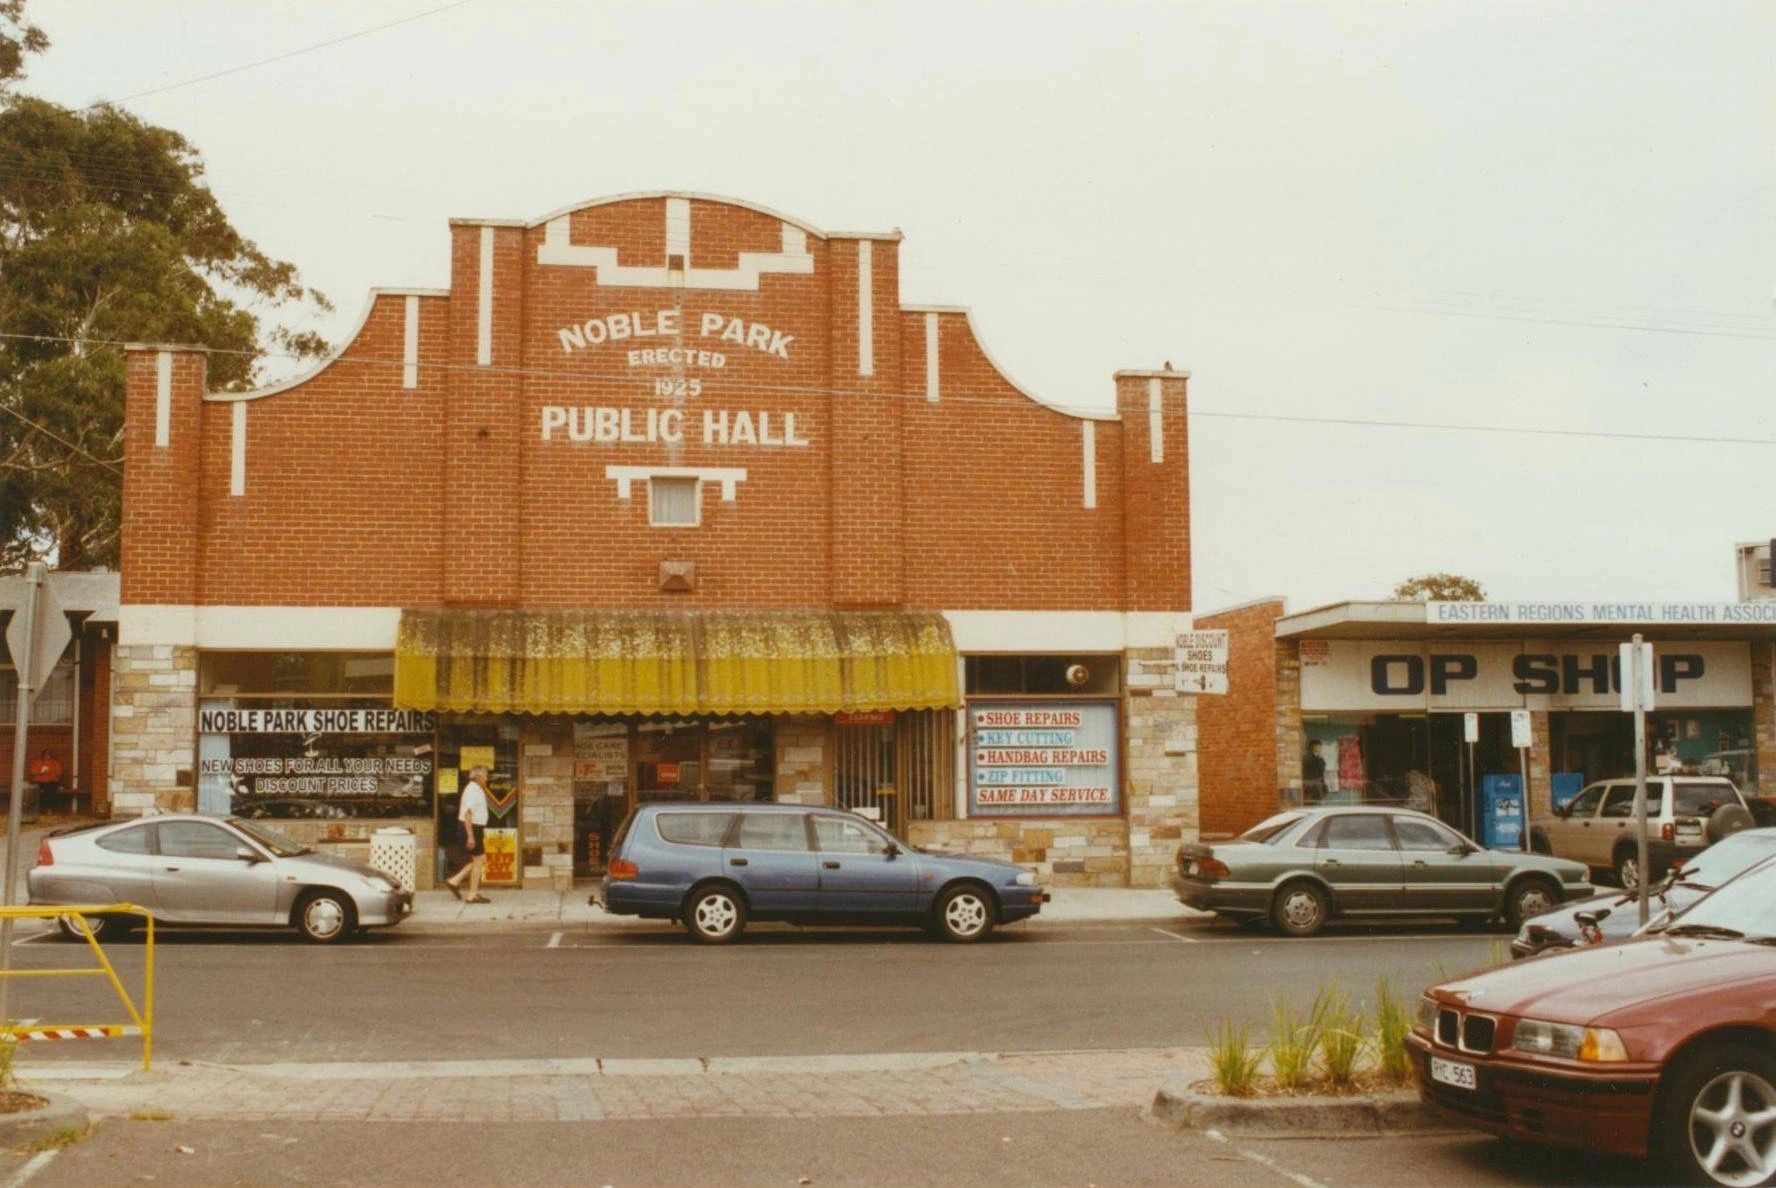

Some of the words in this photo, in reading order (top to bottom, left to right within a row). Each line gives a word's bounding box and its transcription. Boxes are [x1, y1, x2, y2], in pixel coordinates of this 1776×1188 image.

[557, 309, 681, 354] NOBLE
[700, 312, 795, 359] PARK
[627, 348, 726, 369] ERECTED
[655, 378, 702, 397] 1925
[541, 405, 685, 443] PUBLIC
[702, 409, 810, 447] HALL
[1438, 604, 1509, 620] EASTERN
[1518, 604, 1585, 621] REGIONS
[1592, 604, 1654, 621] MENTAL
[1661, 605, 1716, 621] HEALTH
[1187, 650, 1213, 661] SHOES
[1181, 662, 1199, 673] SHOE
[1371, 653, 1478, 696] OP
[201, 711, 259, 732] NOBLE
[263, 711, 309, 732] PARK
[313, 711, 359, 732] SHOE
[364, 710, 435, 732] REPAIRS
[986, 712, 1021, 725] SHOE
[1025, 712, 1081, 725] REPAIRS
[987, 732, 1013, 745] KEY
[1017, 732, 1073, 745] CUTTING
[201, 759, 233, 773] NEW
[234, 757, 282, 775] SHOES
[285, 757, 314, 775] FOR
[316, 757, 342, 775] ALL
[342, 757, 383, 775] YOUR
[385, 757, 432, 776] NEEDS
[987, 751, 1048, 764] HANDBAG
[1052, 751, 1107, 764] REPAIRS
[255, 776, 326, 794] DISCOUNT
[328, 776, 379, 793] PRICES
[987, 770, 1009, 783] ZIP
[1012, 770, 1064, 783] FITTING
[979, 789, 1017, 802] SAME
[1020, 789, 1048, 801] DAY
[1453, 1065, 1474, 1086] 563
